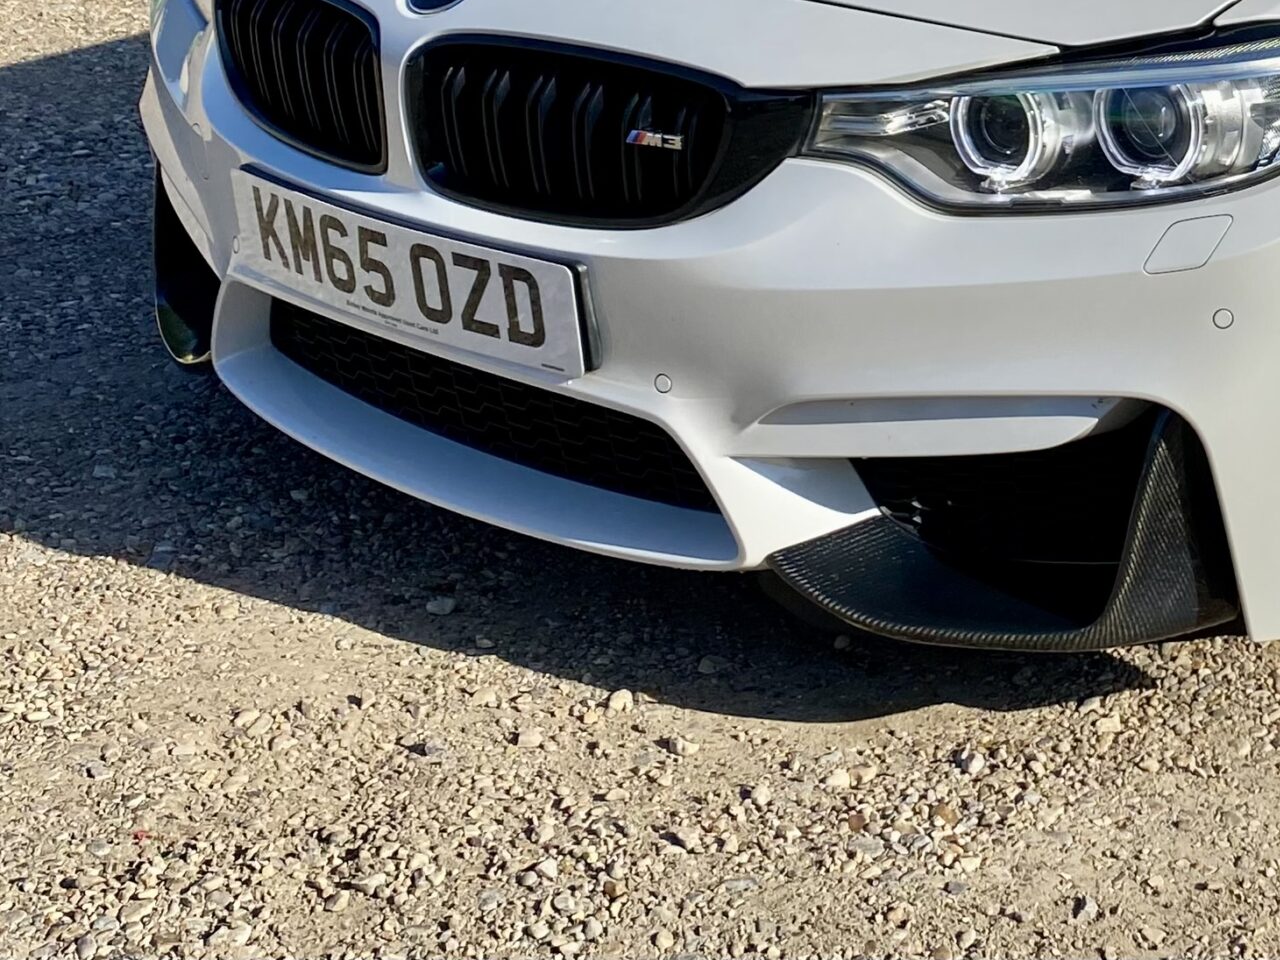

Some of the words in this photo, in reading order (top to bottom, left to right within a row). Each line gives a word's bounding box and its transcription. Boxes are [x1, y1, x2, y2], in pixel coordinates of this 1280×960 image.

[640, 131, 684, 150] M3
[252, 185, 396, 309] KM65
[409, 242, 547, 349] OZD
